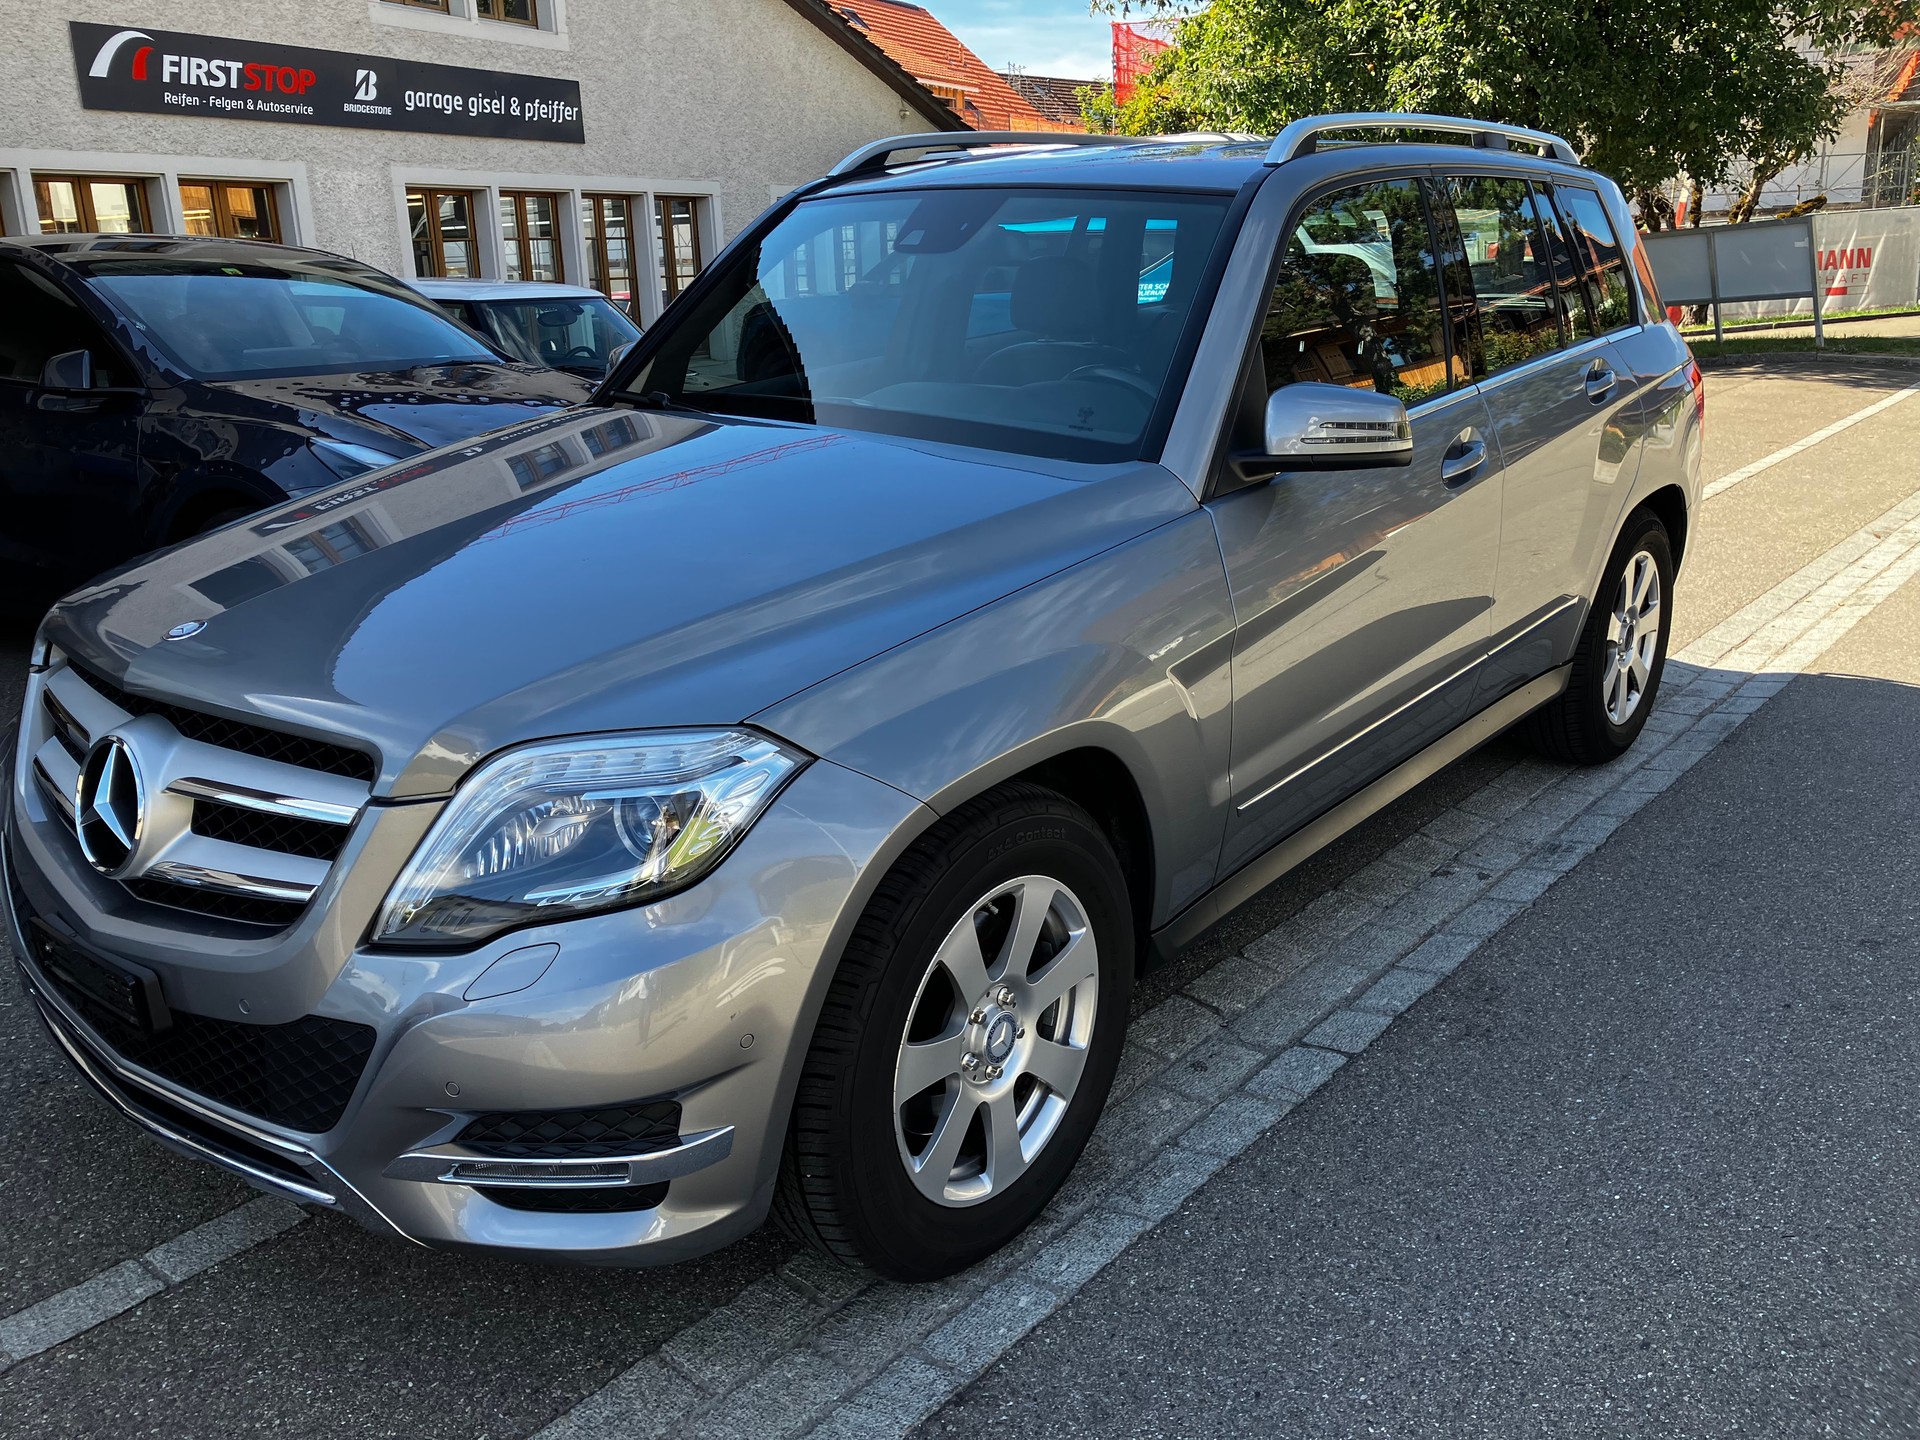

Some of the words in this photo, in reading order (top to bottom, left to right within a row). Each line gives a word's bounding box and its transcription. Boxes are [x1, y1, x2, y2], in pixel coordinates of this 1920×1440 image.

[164, 92, 199, 107] Reifen
[209, 96, 244, 111] Felgen
[247, 99, 254, 110] &
[256, 100, 314, 115] Autoservice
[343, 103, 392, 115] BRIDGESTONE
[404, 89, 463, 114] garage
[468, 93, 505, 116] gisel
[510, 97, 521, 116] &
[525, 99, 579, 123] pfeiffer
[1015, 826, 1066, 844] Contact
